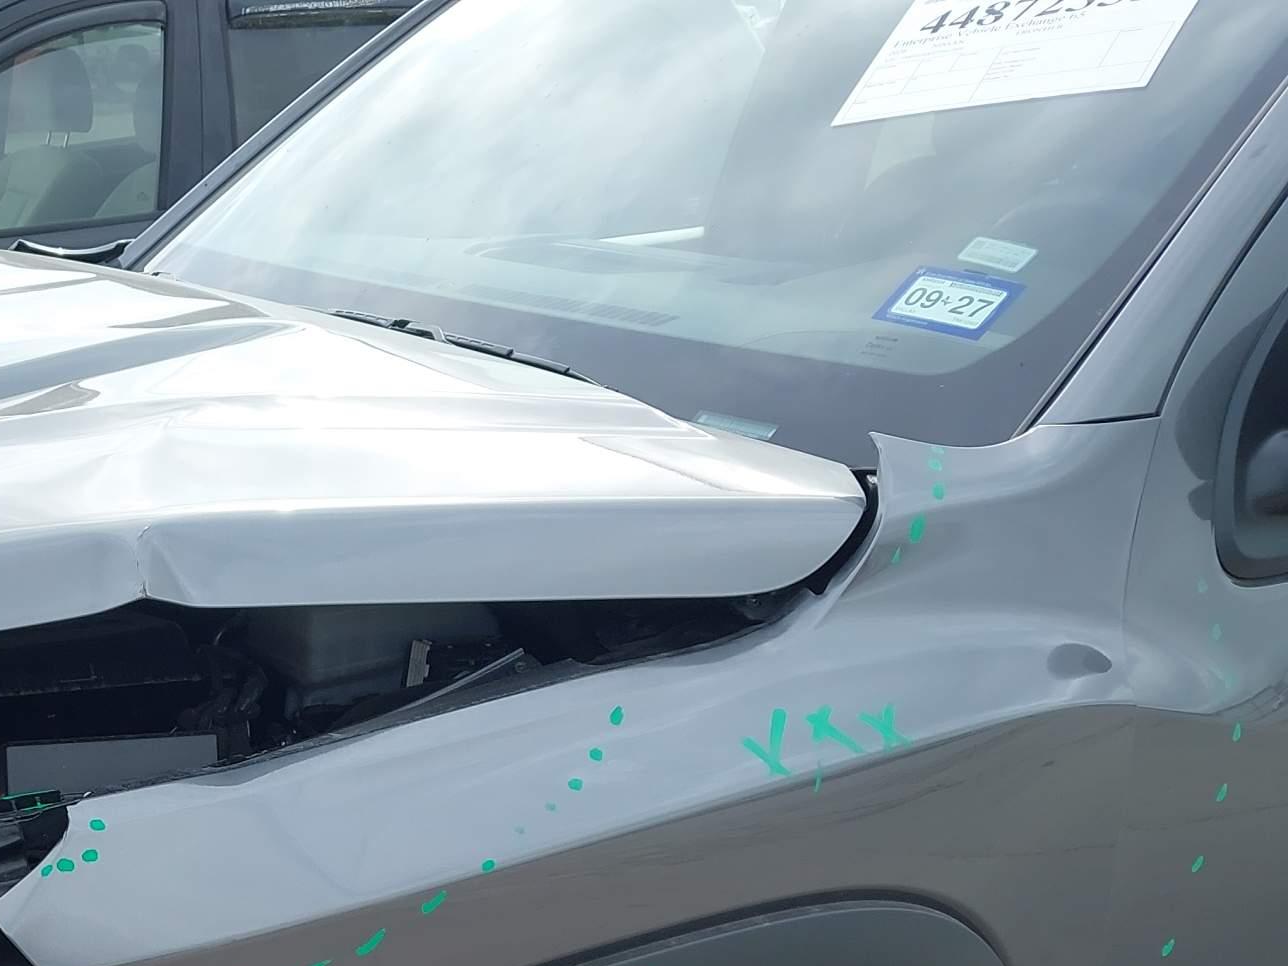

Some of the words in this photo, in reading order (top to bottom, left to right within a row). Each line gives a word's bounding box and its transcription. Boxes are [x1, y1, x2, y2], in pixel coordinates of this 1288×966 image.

[920, 0, 1142, 34] 44872
[903, 287, 944, 309] 09
[947, 295, 995, 318] 27
